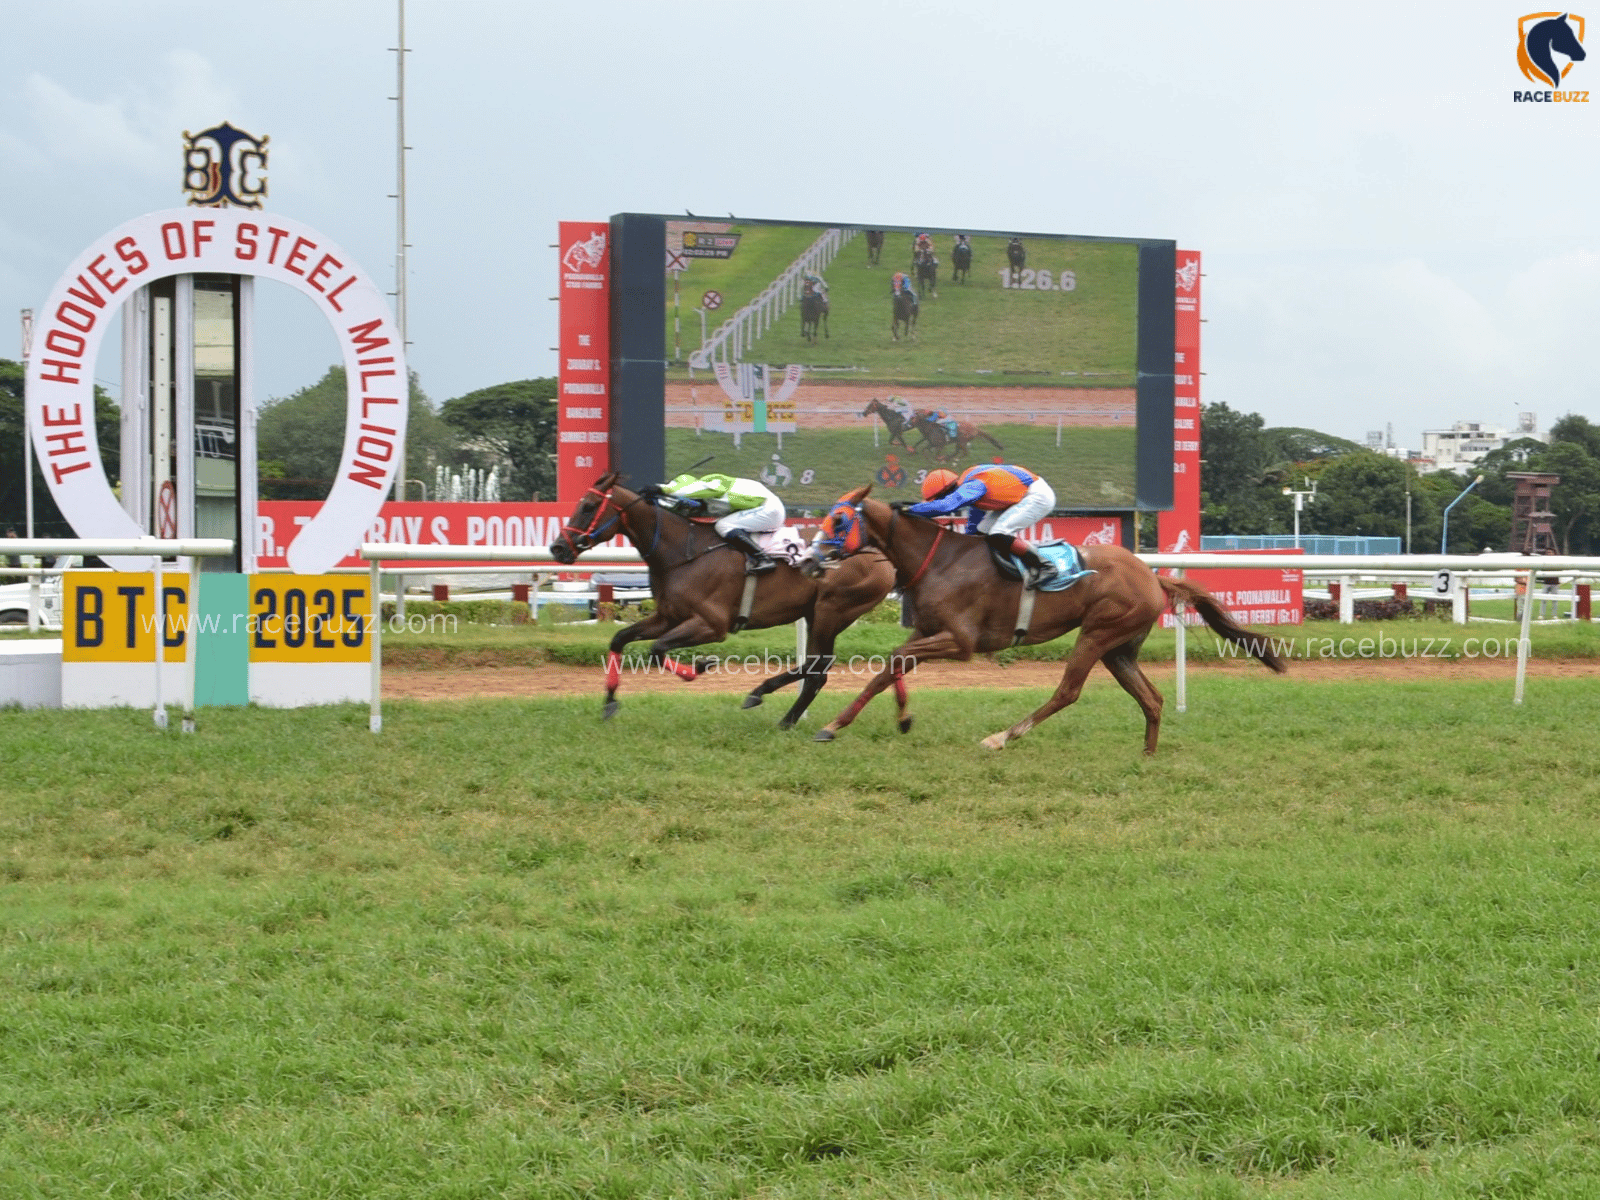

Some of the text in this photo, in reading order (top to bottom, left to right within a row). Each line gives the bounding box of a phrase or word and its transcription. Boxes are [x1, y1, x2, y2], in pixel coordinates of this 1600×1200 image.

[998, 267, 1077, 291] 1:26.6
[40, 220, 399, 491] THE HOOVES OF STEEL MILLION
[800, 469, 815, 484] 8
[914, 469, 928, 484] 3
[1437, 572, 1450, 593] 3
[254, 588, 365, 648] 2025
